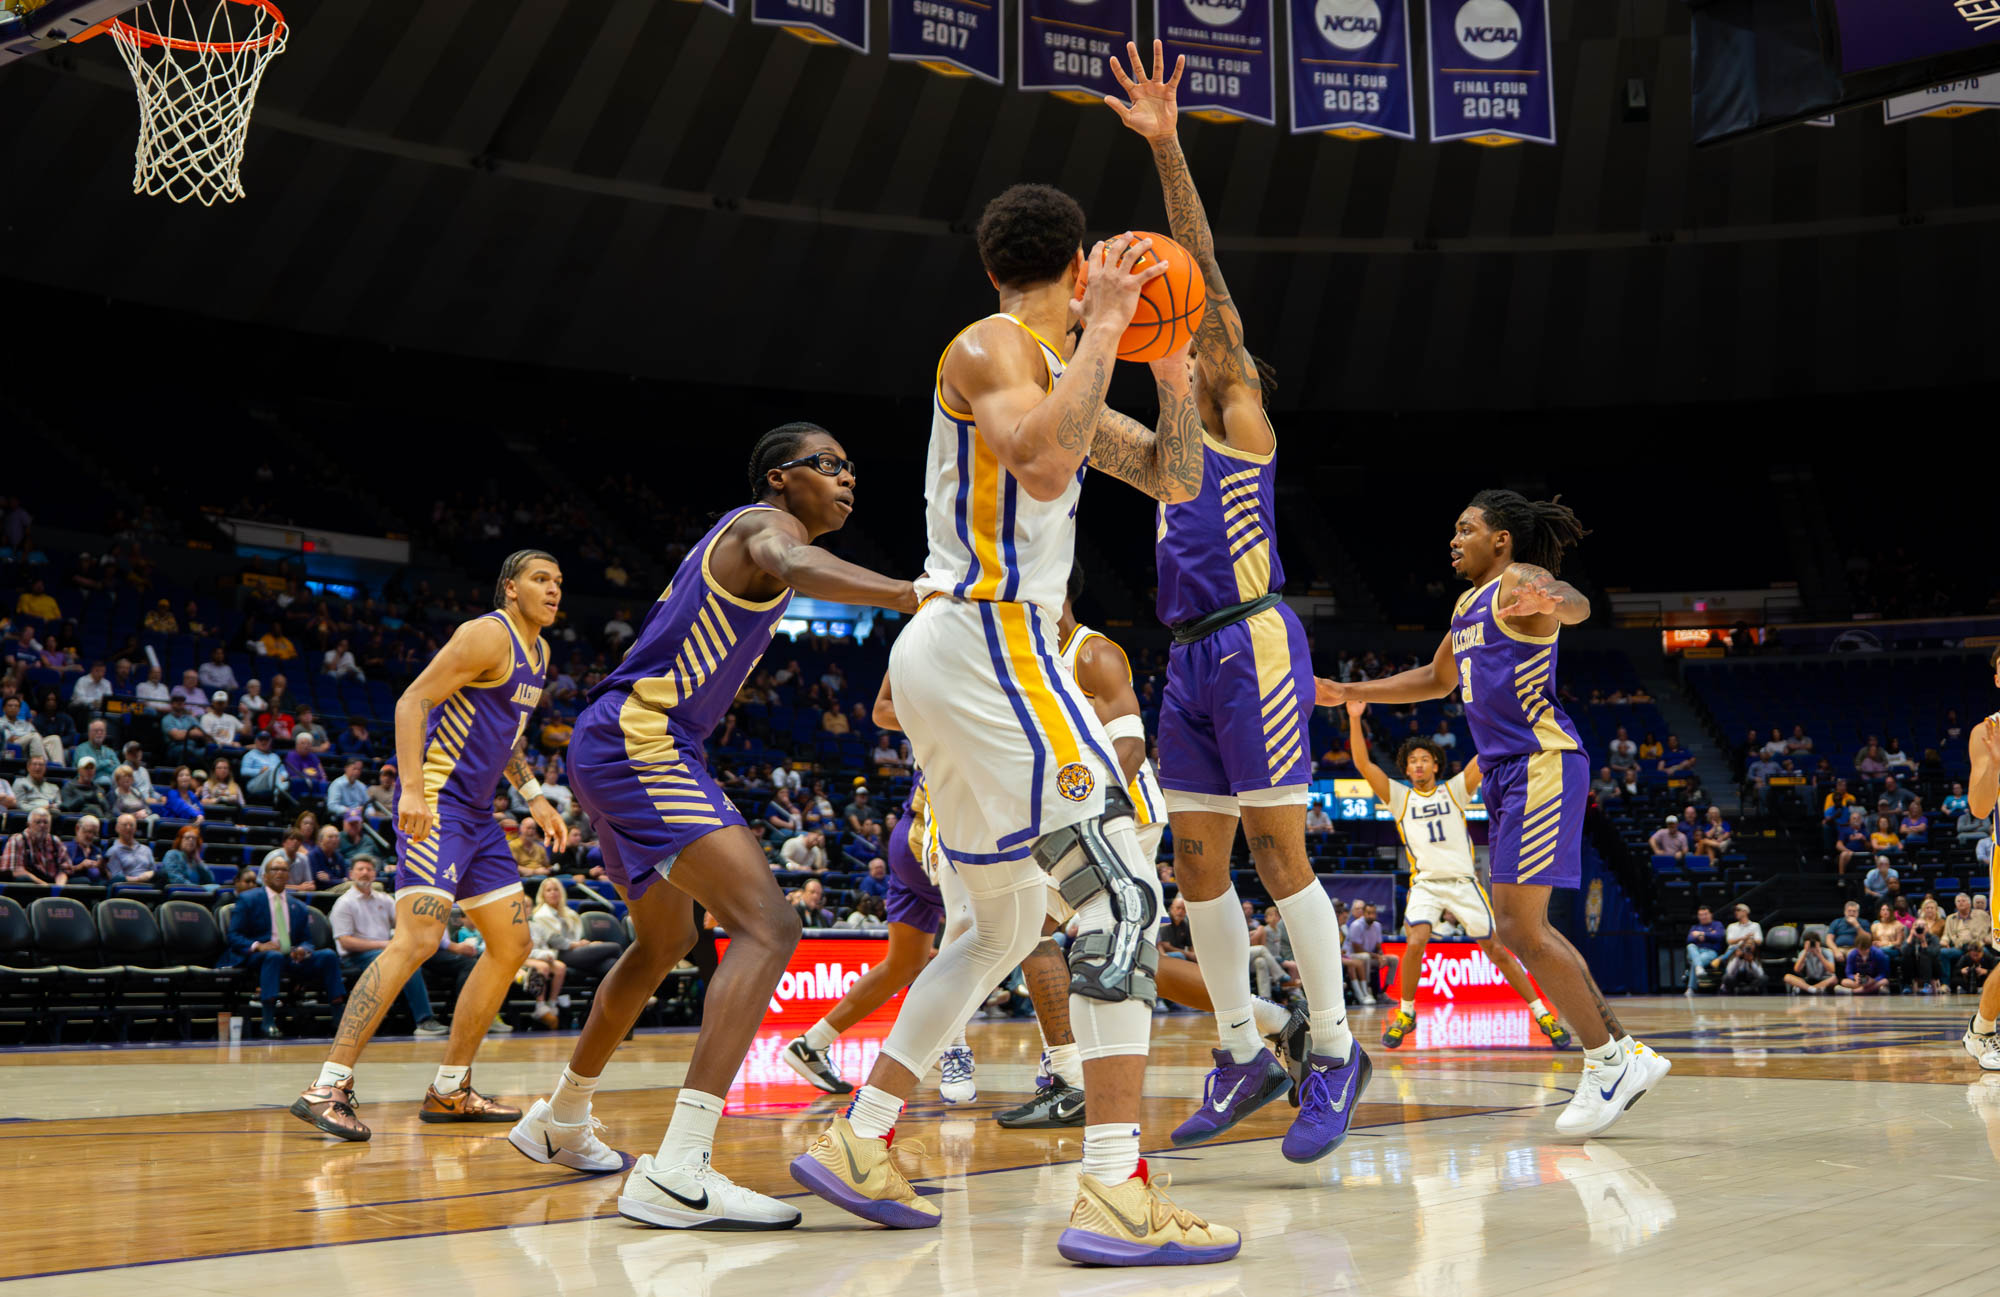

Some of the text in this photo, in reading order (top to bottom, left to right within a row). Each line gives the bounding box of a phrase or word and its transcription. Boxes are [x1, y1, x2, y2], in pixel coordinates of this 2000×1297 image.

[913, 0, 978, 29] SUPER SIX
[1324, 14, 1379, 33] NCAA
[922, 19, 969, 50] 2017
[1044, 31, 1111, 55] SUPER SIX
[1463, 26, 1520, 43] NCAA
[1053, 50, 1103, 78] 2018
[1183, 54, 1251, 75] INAL FOUR
[1190, 71, 1240, 97] 2019
[1313, 71, 1388, 89] FINAL FOUR
[1453, 81, 1528, 95] FINAL FOUR
[1323, 89, 1380, 112] 2023
[1463, 97, 1521, 119] 2024
[1459, 656, 1474, 704] 3
[1411, 801, 1451, 820] LSU
[1426, 819, 1447, 844] 11
